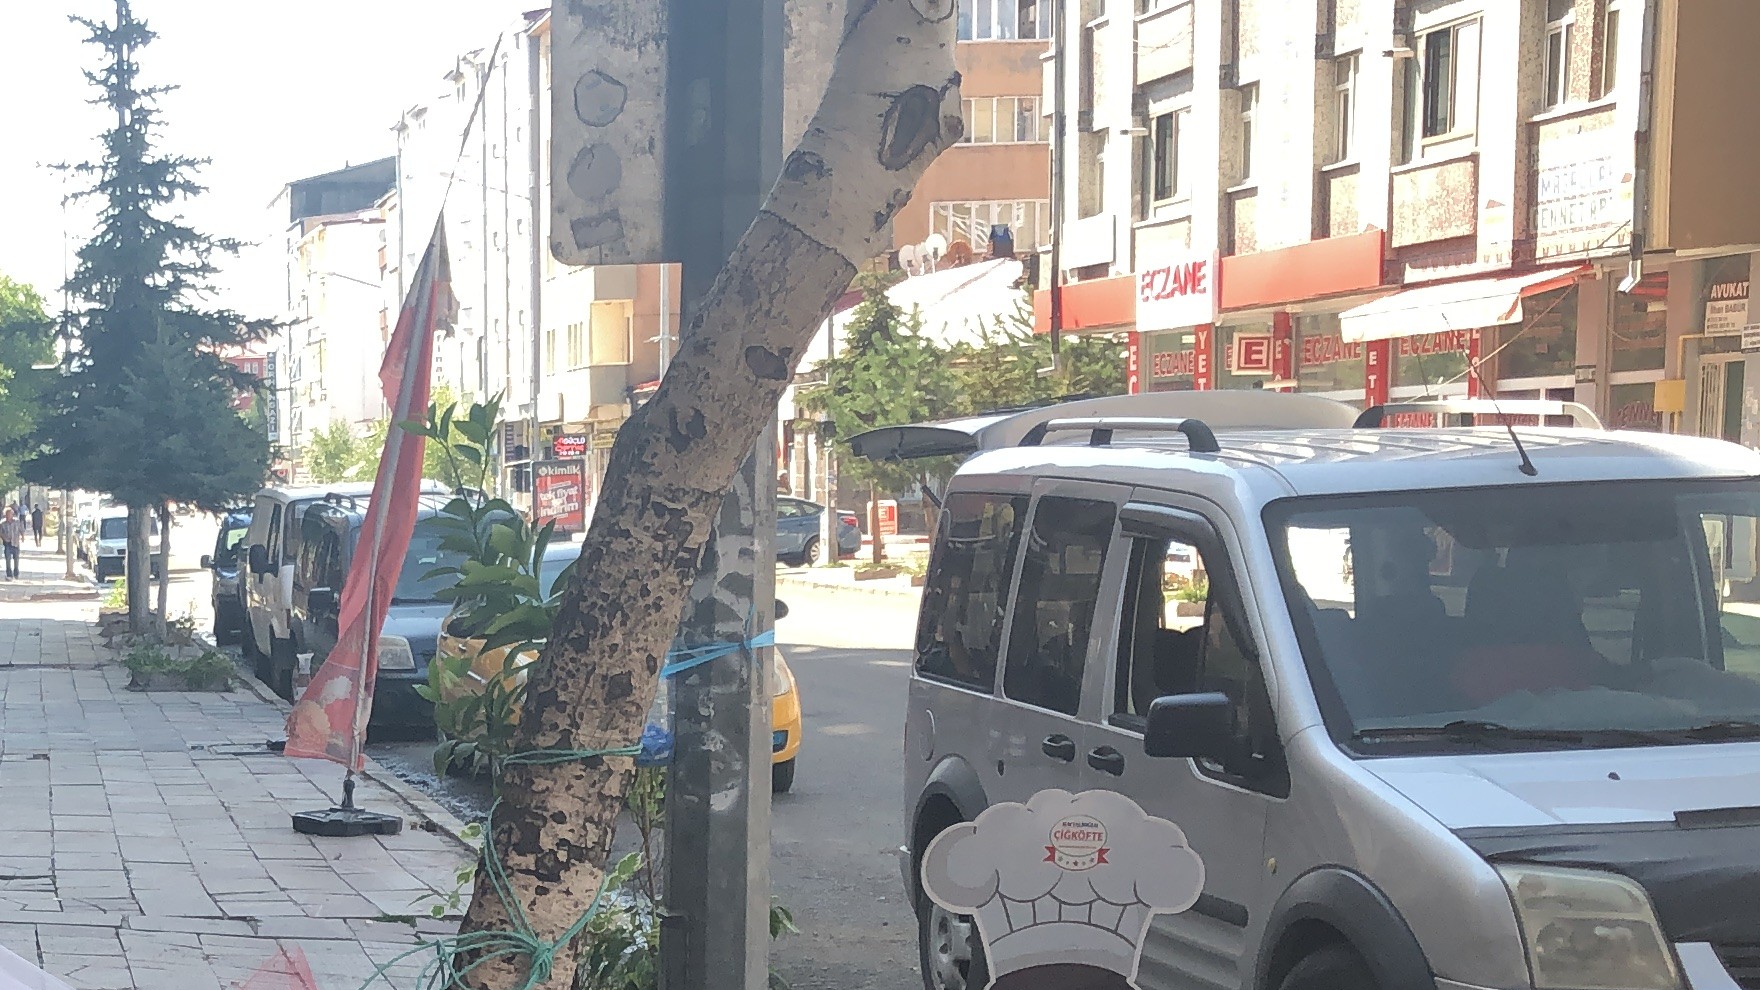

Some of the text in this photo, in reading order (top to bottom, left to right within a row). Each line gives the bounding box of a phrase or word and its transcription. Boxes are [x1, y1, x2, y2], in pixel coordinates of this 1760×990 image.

[1141, 260, 1207, 302] ECZANE
[1710, 281, 1749, 299] AVUKAT
[1153, 350, 1195, 378] ECZANE
[548, 465, 580, 476] kimlik
[1053, 829, 1104, 842] ÇİĞKÖFTE
